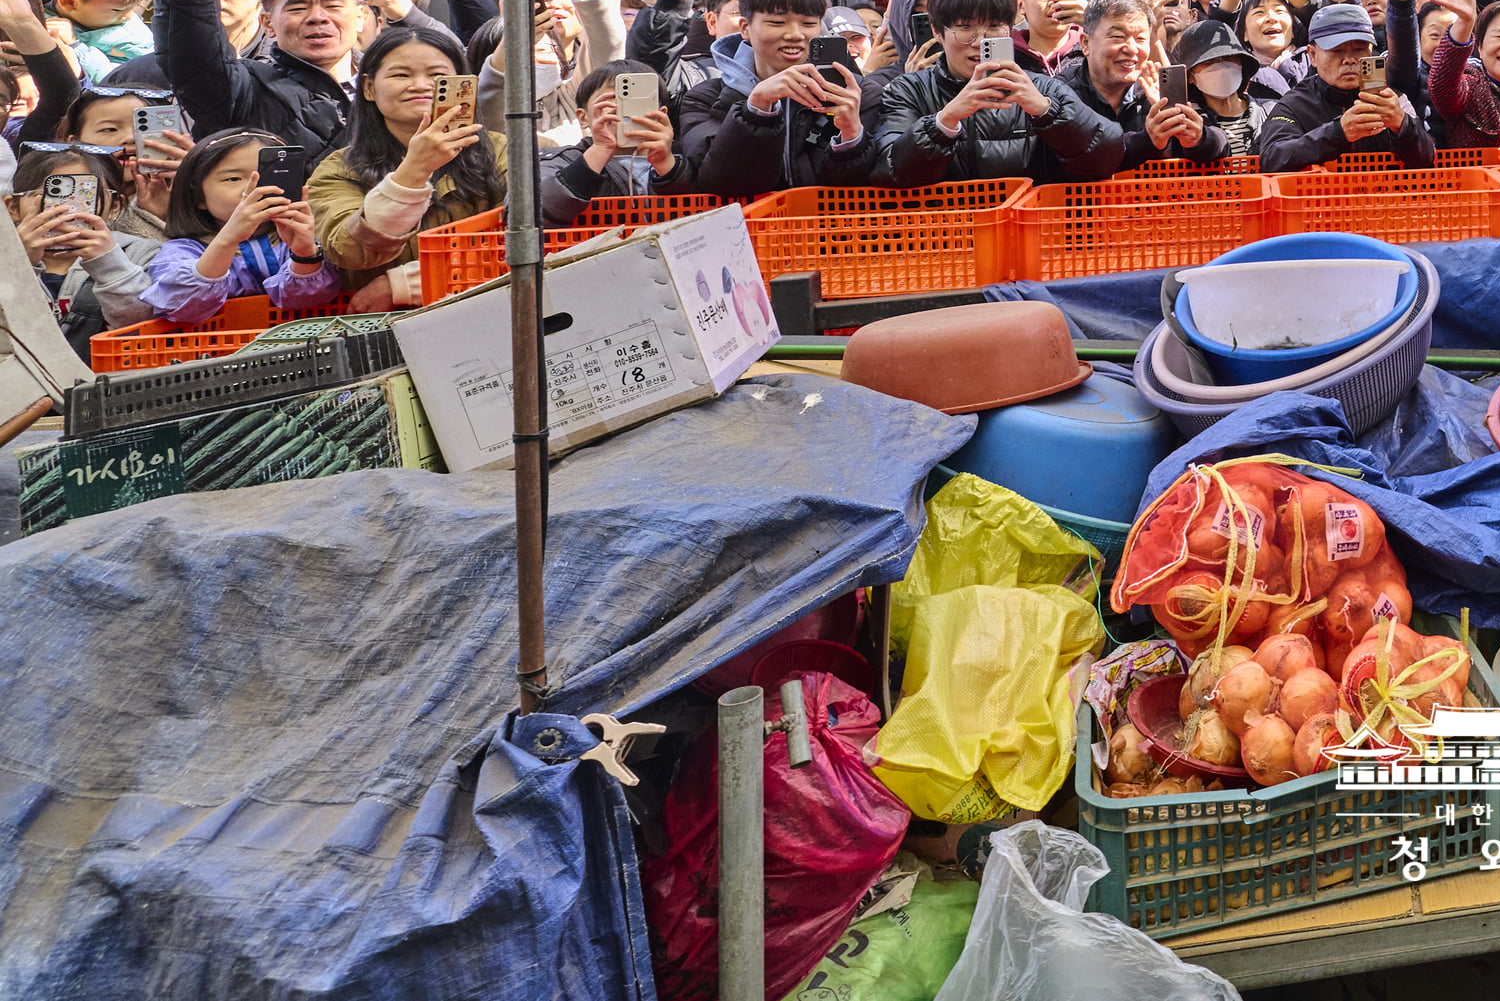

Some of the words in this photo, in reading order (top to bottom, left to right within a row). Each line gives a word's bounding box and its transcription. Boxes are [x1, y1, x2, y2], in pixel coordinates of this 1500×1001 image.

[586, 366, 602, 377] 전화
[554, 373, 577, 386] 진주시
[592, 382, 608, 393] 개수
[621, 384, 644, 396] 진주시
[555, 398, 574, 409] 10kg
[597, 394, 612, 405] 주소
[66, 447, 175, 486] 가시오이
